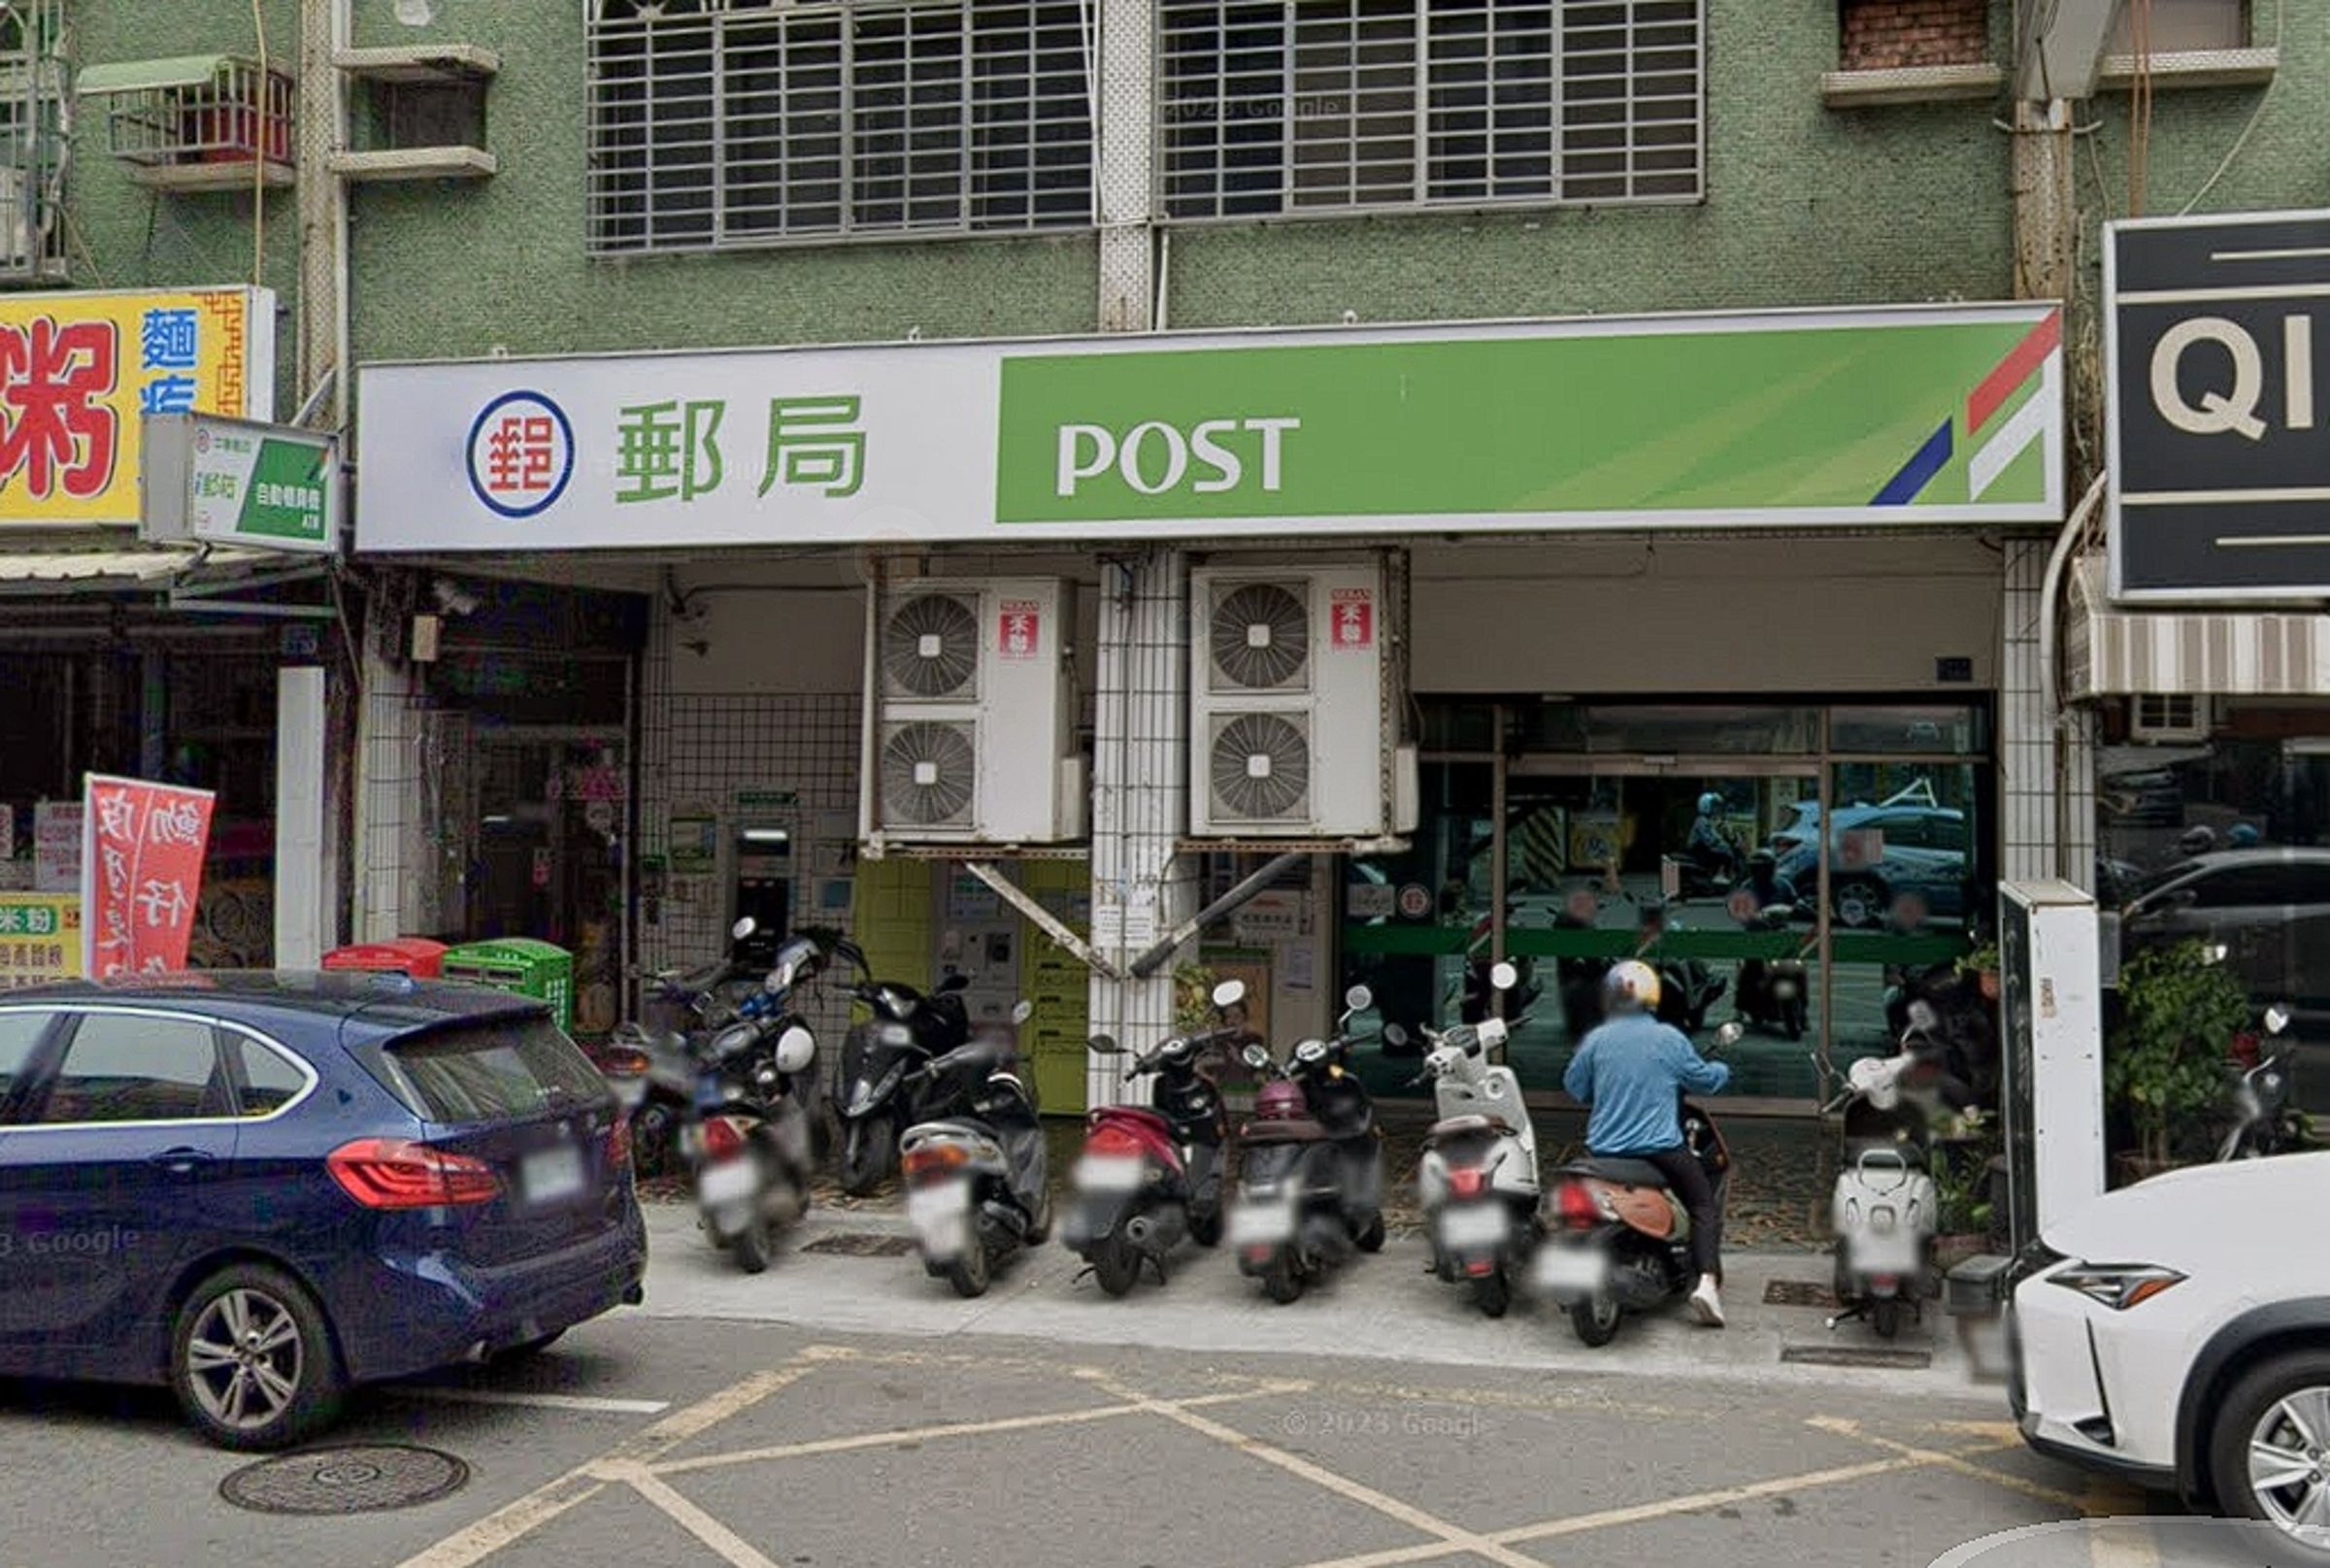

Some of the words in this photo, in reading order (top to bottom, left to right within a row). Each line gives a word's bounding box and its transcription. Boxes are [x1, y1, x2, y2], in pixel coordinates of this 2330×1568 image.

[2150, 314, 2313, 442] QI
[616, 395, 867, 504] 郵局
[1056, 417, 1301, 496] POST
